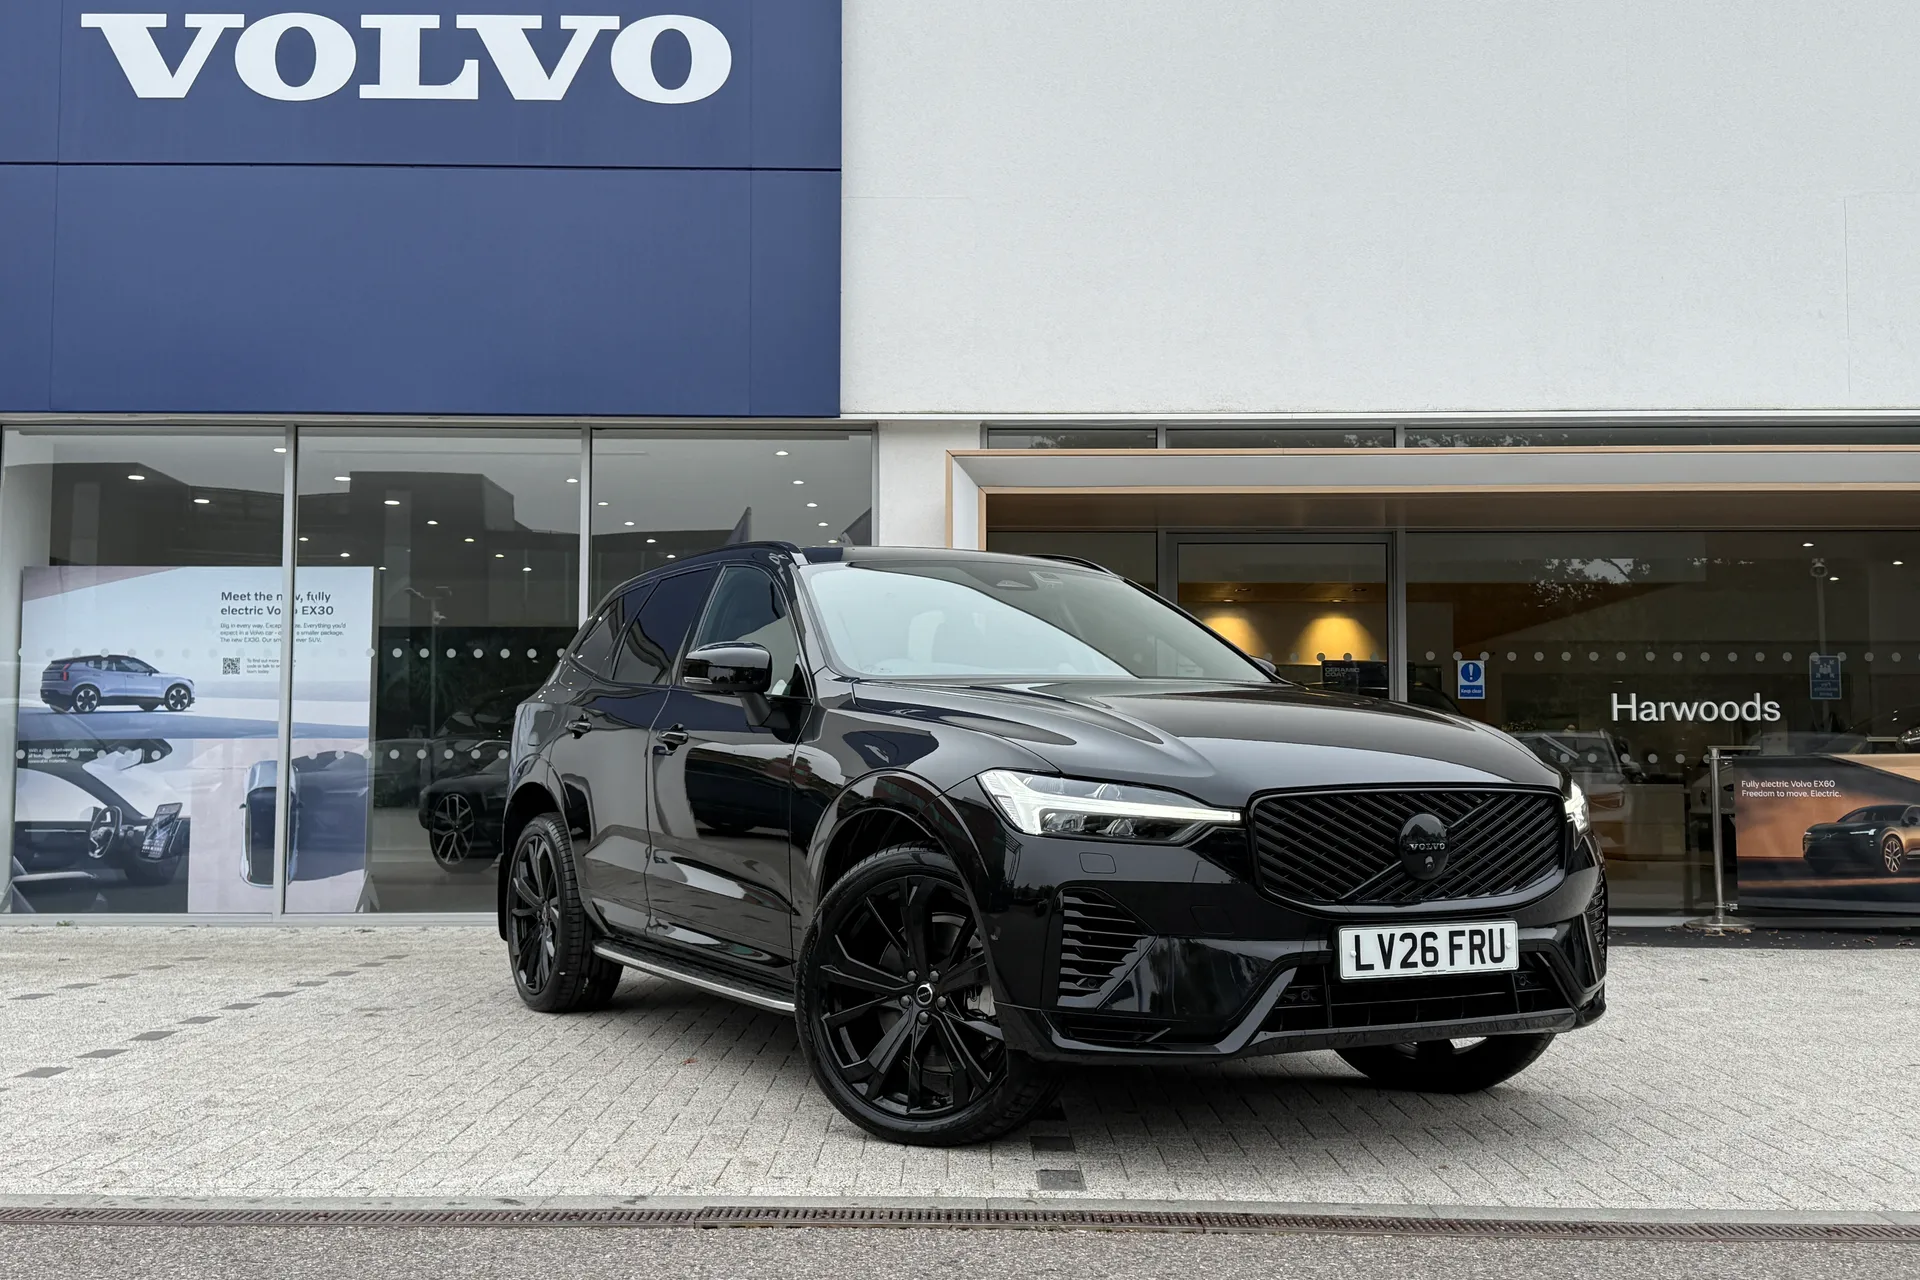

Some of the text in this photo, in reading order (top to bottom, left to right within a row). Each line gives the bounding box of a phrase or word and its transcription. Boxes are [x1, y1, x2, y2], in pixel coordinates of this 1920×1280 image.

[81, 12, 732, 104] VOLVO
[221, 591, 331, 603] Meet the nw, fully
[220, 605, 264, 615] electric
[301, 605, 334, 615] EX30
[1611, 692, 1781, 722] Harwoods
[1741, 779, 1836, 789] Fully electric Volvo EX60
[1741, 789, 1775, 797] Freedom
[1810, 789, 1842, 798] Electric.
[1409, 842, 1446, 850] VOLVO
[1354, 928, 1505, 971] LV26 FRU
